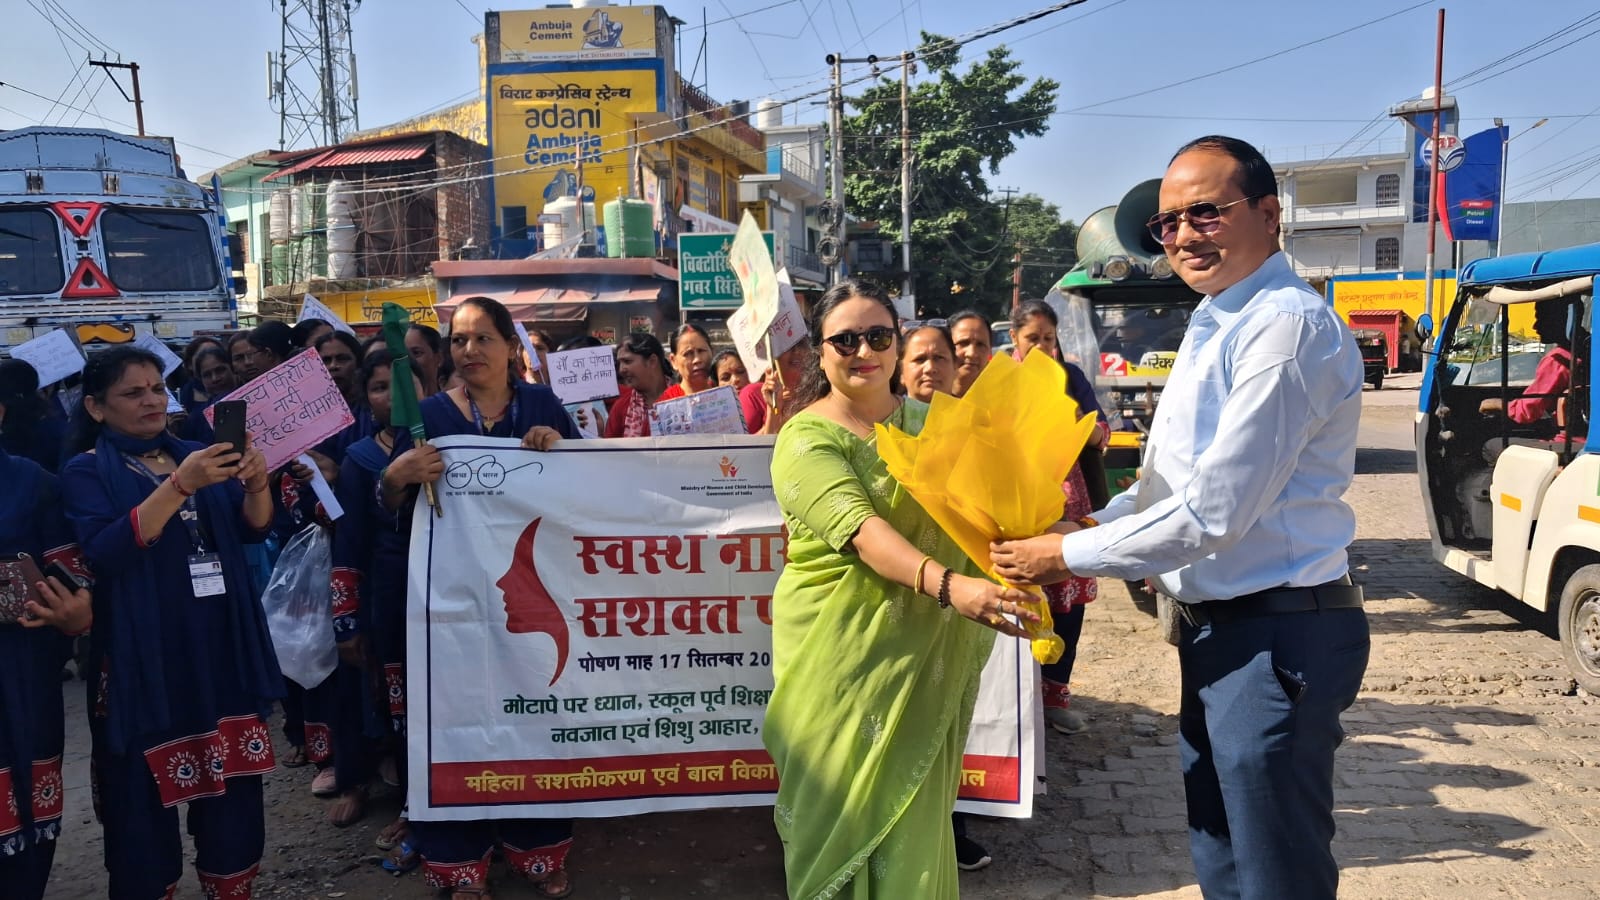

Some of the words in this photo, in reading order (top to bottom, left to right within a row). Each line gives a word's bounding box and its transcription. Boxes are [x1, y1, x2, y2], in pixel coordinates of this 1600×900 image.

[529, 31, 573, 40] Cement
[530, 20, 572, 31] Ambuja
[499, 84, 533, 99] विराट
[536, 82, 592, 100] कम्प्रेसिव
[525, 101, 600, 129] adani
[526, 131, 602, 151] Ambuja
[524, 149, 603, 165] Cement
[682, 250, 735, 273] विक्टोरि
[1104, 353, 1124, 376] 2
[273, 386, 304, 414] नारी
[573, 534, 708, 575] स्वस्थ
[574, 596, 746, 638] सशक्त
[578, 651, 620, 672] पोषण
[624, 654, 653, 670] माह
[659, 653, 681, 669] 17
[687, 648, 744, 668] सितम्बर
[749, 652, 770, 667] 20
[503, 694, 559, 714] मोटापे
[563, 697, 590, 714] पर
[594, 694, 643, 711] ध्यान,
[648, 691, 696, 714] स्कूल
[700, 685, 727, 712] पूर्व
[550, 725, 617, 743] नवजात
[621, 718, 651, 743] एवं
[655, 717, 694, 744] शिशु
[699, 718, 759, 736] आहार,
[464, 770, 527, 793] महिला
[532, 766, 647, 790] सशक्तीकरण
[652, 763, 681, 786] एवं
[686, 765, 725, 782] बाल
[730, 758, 776, 781] विका
